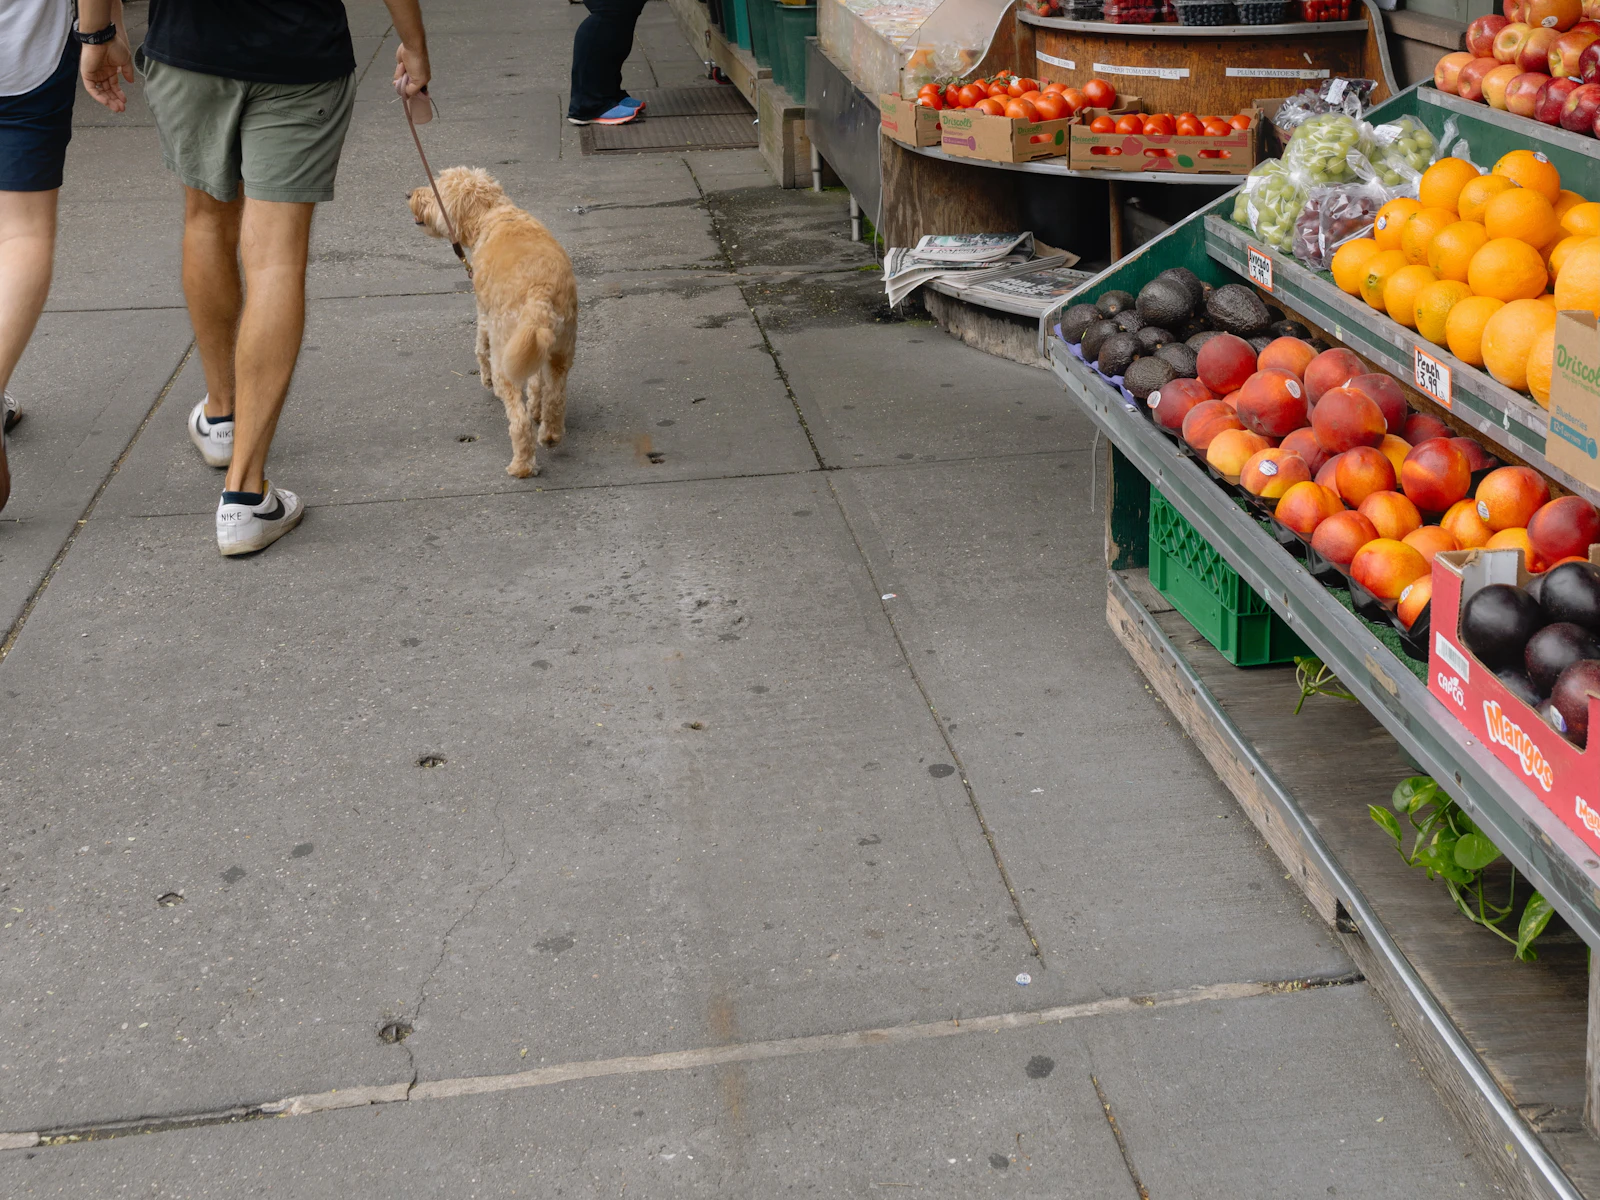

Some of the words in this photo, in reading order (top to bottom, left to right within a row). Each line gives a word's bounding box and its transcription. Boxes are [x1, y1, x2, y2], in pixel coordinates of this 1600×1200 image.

[1100, 65, 1125, 73] REGULAR
[1125, 68, 1157, 76] TOMATOES
[1417, 350, 1441, 381] Peach
[1556, 404, 1588, 432] Blueberries
[1437, 671, 1465, 707] CAPCO
[1482, 699, 1554, 792] Mangos
